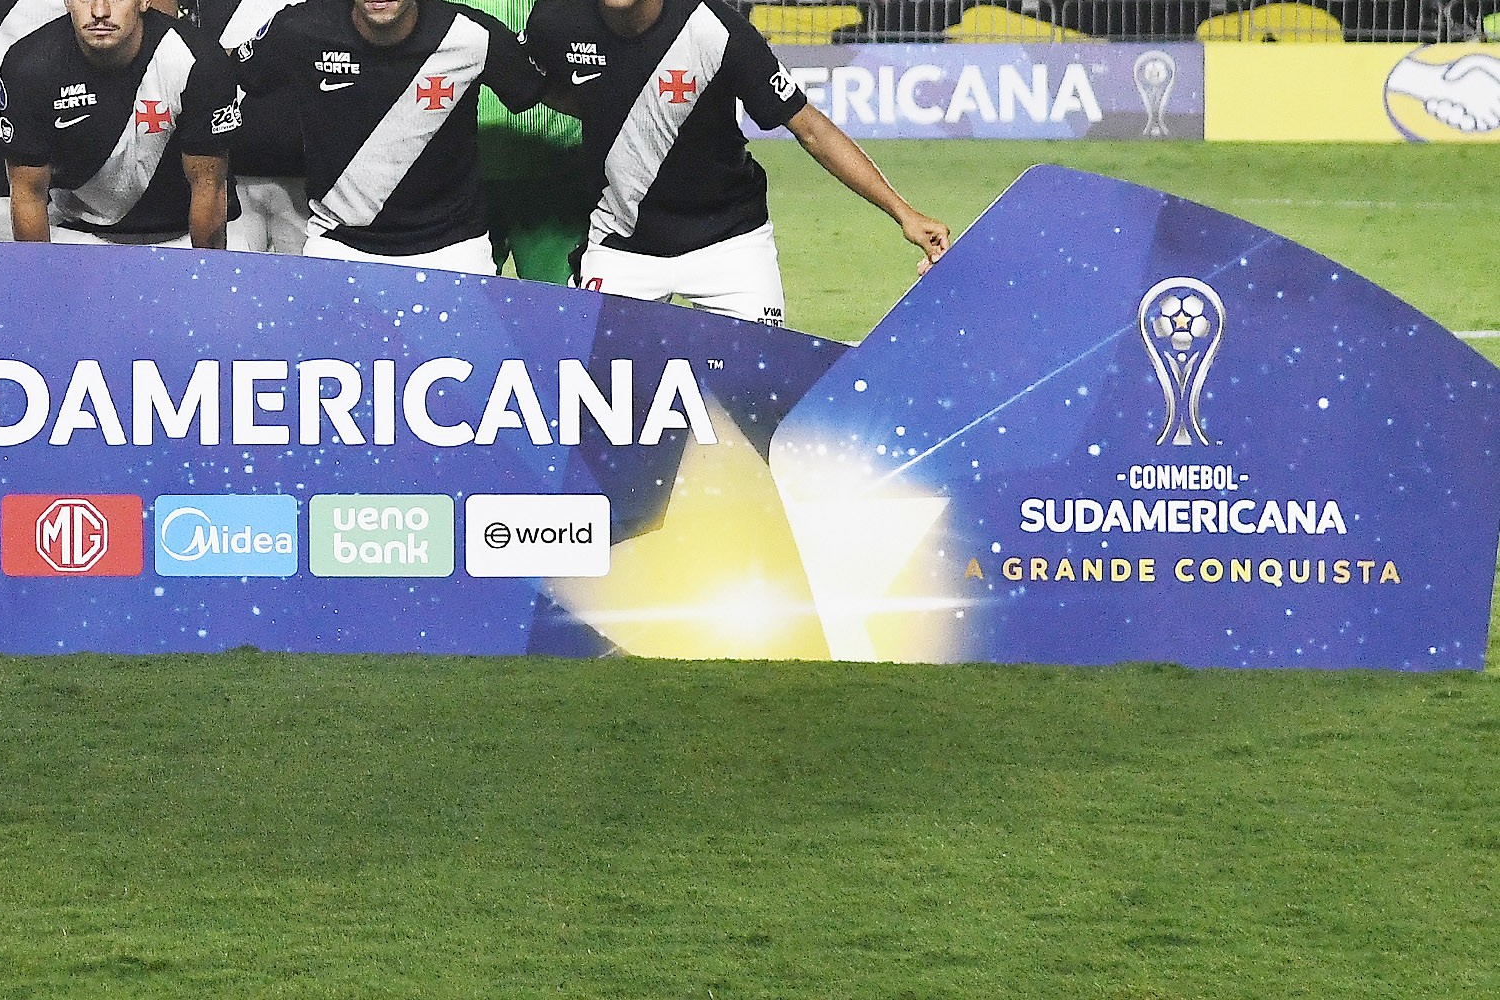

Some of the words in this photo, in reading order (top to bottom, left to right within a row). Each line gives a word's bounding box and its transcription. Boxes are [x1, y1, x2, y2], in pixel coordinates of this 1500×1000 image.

[322, 51, 350, 63] VIVA
[566, 52, 607, 66] SORTE
[571, 42, 597, 54] VIVA
[315, 61, 361, 75] SORTE
[60, 83, 87, 97] VIVA
[790, 63, 1102, 124] ERICANA
[53, 93, 97, 110] SORTE
[333, 506, 429, 531] ueno
[1019, 498, 1347, 535] SUDAMERICANA
[42, 505, 102, 565] MG
[515, 522, 593, 544] world
[333, 533, 429, 564] bank
[964, 557, 984, 579] A
[1002, 557, 1156, 583] GRANDE
[1174, 557, 1403, 588] CONQUISTA
